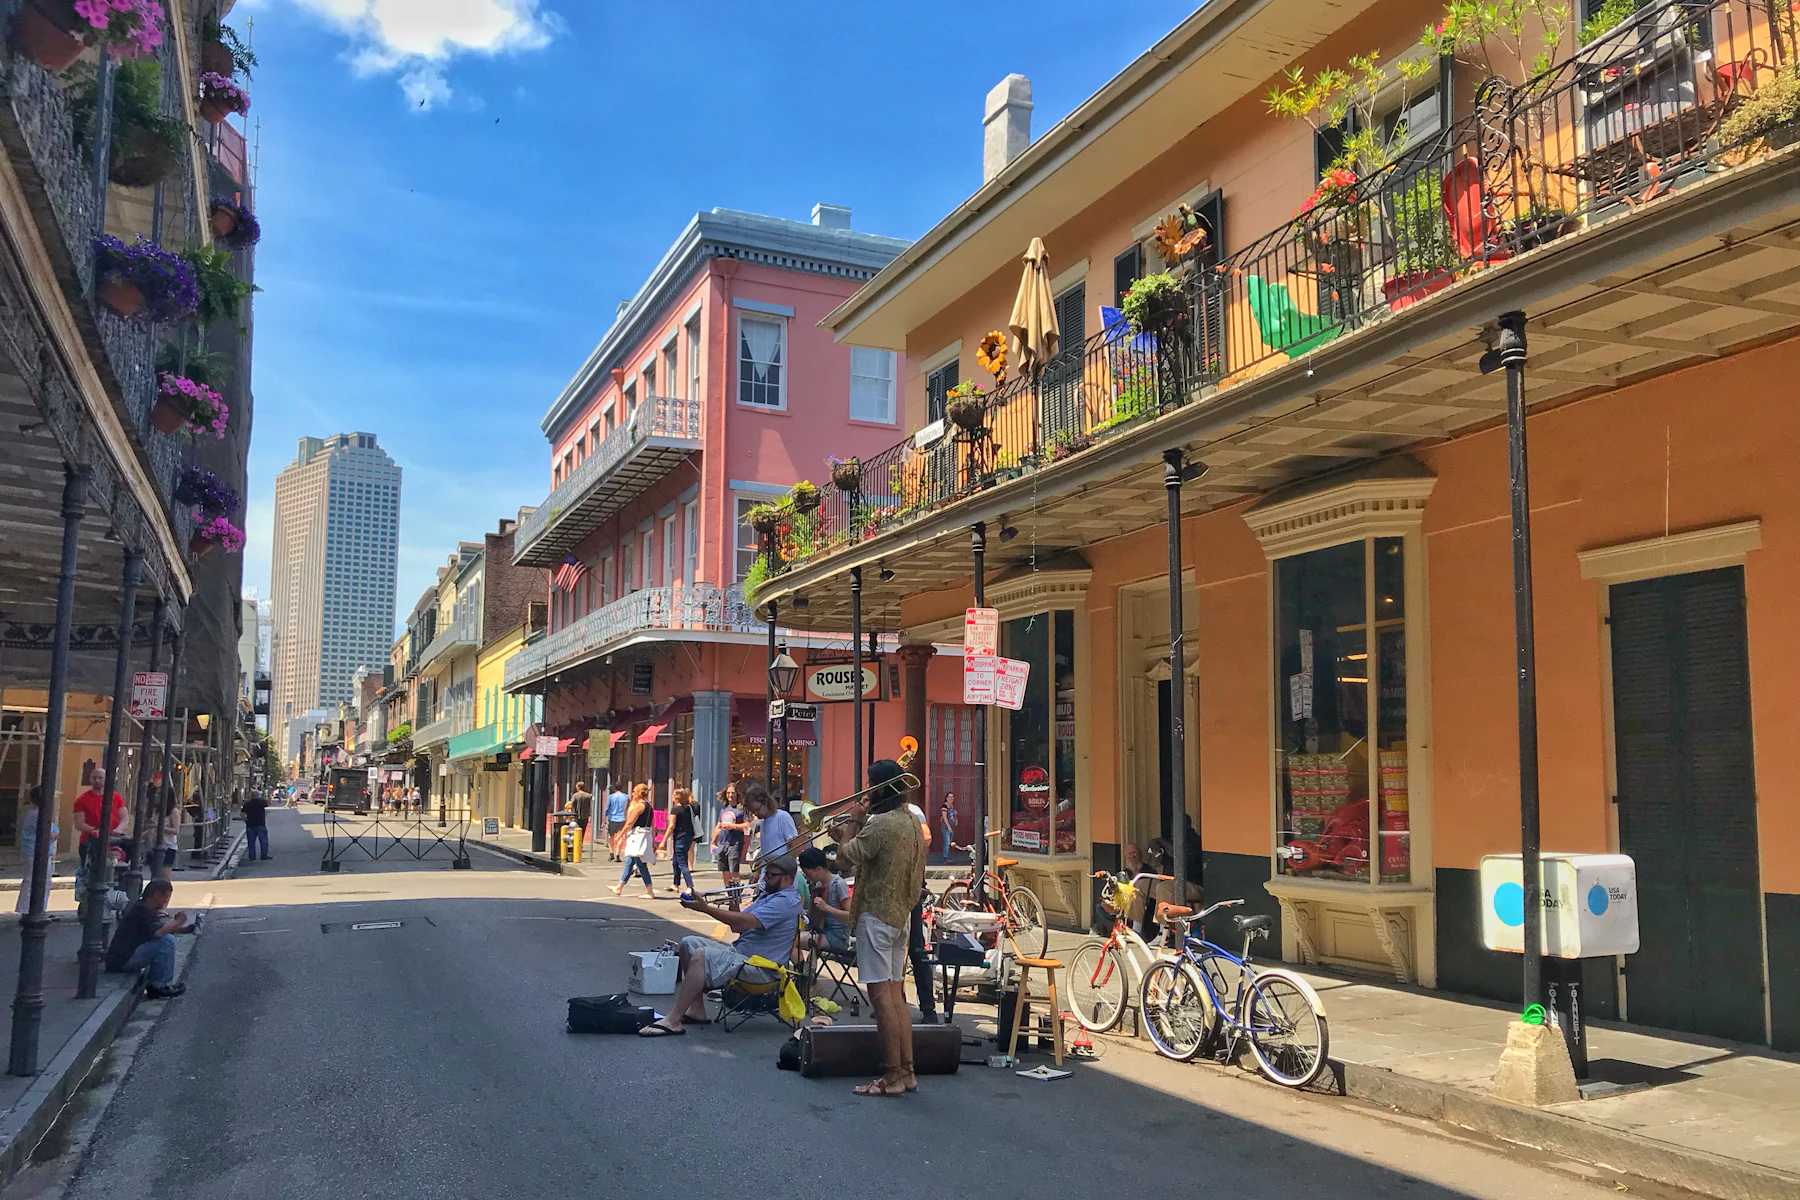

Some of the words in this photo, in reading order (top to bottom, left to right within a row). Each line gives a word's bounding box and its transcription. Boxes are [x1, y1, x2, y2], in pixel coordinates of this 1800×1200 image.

[135, 674, 146, 685] NO
[998, 674, 1023, 686] FREIGHT
[140, 688, 157, 696] FIRE
[1000, 683, 1017, 691] ZONE
[138, 698, 157, 706] LANE
[792, 708, 815, 718] Peter
[1056, 703, 1072, 716] BUD
[1571, 989, 1580, 1045] GANNETT
